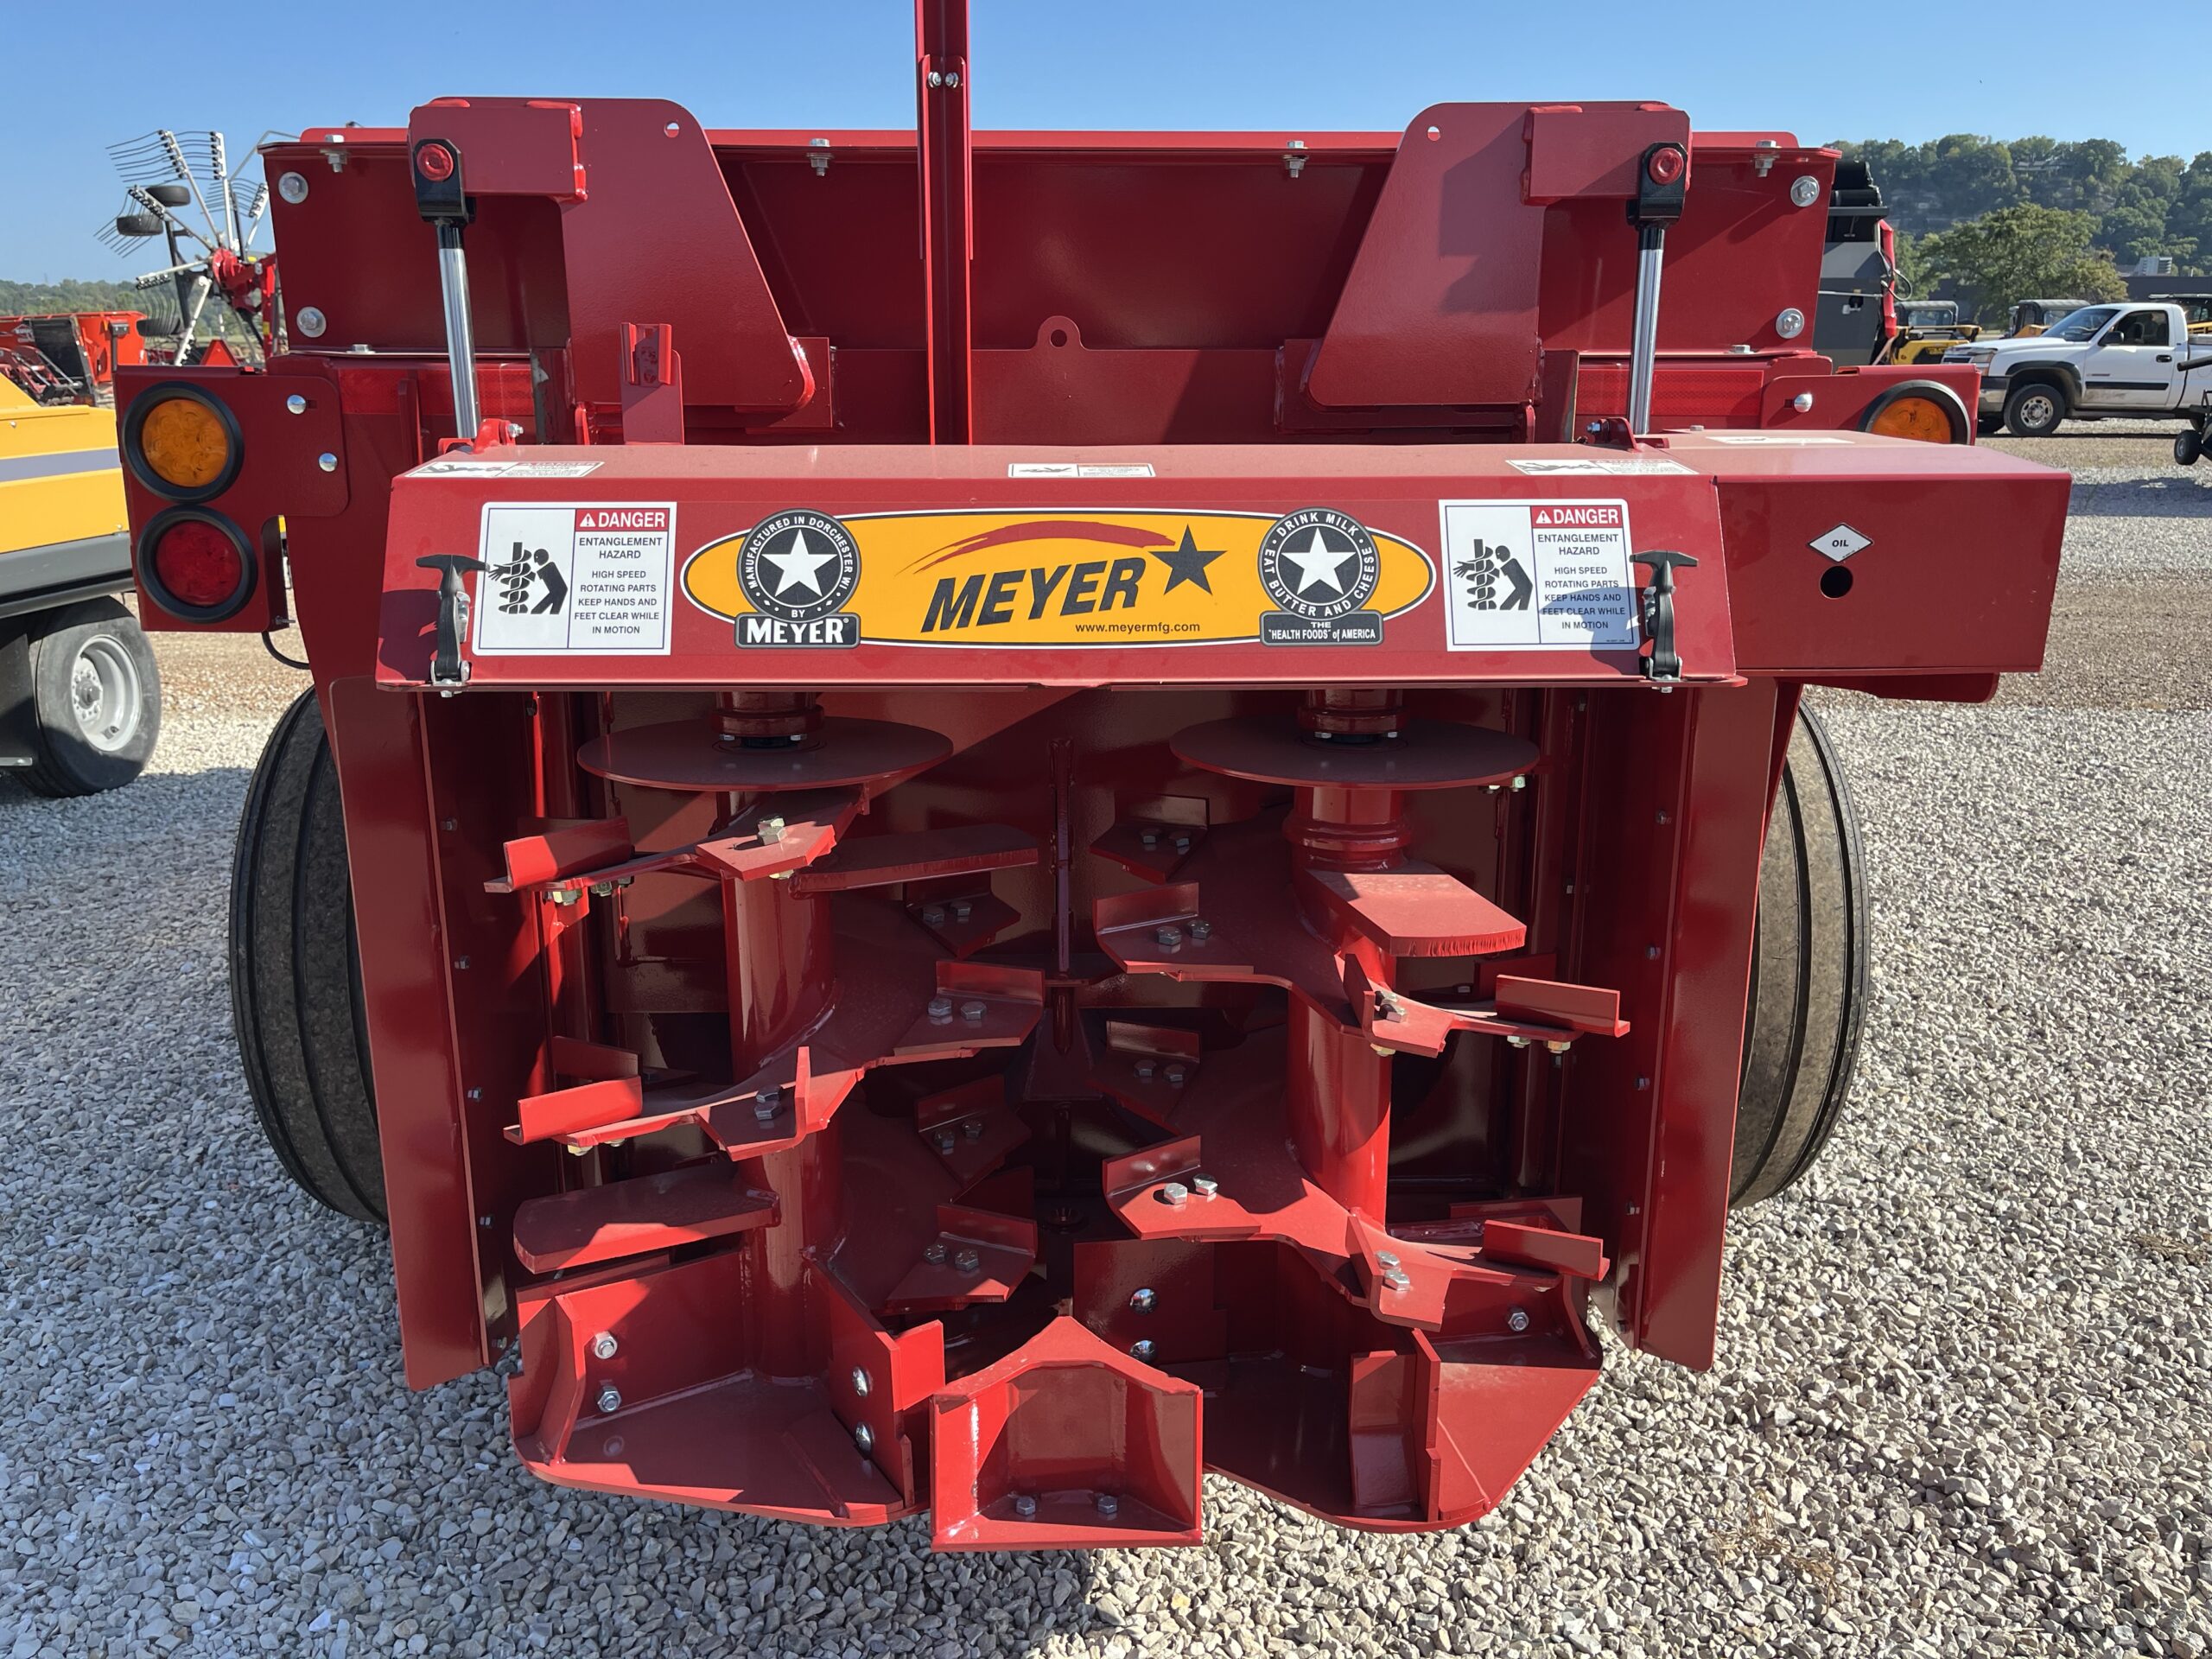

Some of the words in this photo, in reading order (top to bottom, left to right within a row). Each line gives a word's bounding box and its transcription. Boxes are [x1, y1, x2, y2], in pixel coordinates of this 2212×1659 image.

[598, 512, 665, 528] DANGER
[1553, 508, 1619, 524] DANGER
[1276, 512, 1319, 538] DRINK
[1325, 512, 1360, 537] MILK
[579, 537, 663, 546] ENTANGLEMENT
[1537, 534, 1619, 543] ENTANGLEMENT
[1832, 539, 1849, 548] OIL
[599, 550, 641, 559] HAZARD
[745, 518, 791, 589] MANUFACTURED
[794, 516, 805, 524] IN
[809, 517, 853, 574] DORCHESTER
[838, 576, 852, 590] WI
[1559, 546, 1600, 556] HAZARD
[1263, 548, 1276, 575] EAT
[592, 570, 614, 579] HIGH
[617, 570, 646, 579] SPEED
[1354, 546, 1375, 599] CHEESE
[580, 584, 626, 593] ROTATING
[627, 584, 657, 593] PARTS
[1544, 580, 1589, 588] ROTATING
[1591, 580, 1619, 588] PARTS
[920, 557, 1147, 633] MEYER
[1268, 580, 1316, 617] BUTTER
[1544, 594, 1567, 602] KEEP
[1569, 594, 1601, 602] HANDS
[1603, 594, 1622, 602] AND
[578, 598, 602, 607] KEEP
[604, 598, 636, 607] HANDS
[638, 598, 658, 607] AND
[1324, 599, 1352, 617] AND
[574, 612, 596, 620] FEET
[598, 612, 629, 620] CLEAR
[631, 612, 660, 620] WHILE
[791, 609, 805, 618] BY
[592, 626, 602, 634] IN
[603, 626, 640, 634] MOTION
[1075, 622, 1201, 635] www.meyermfg.com
[1561, 621, 1572, 630] IN
[1573, 621, 1609, 630] MOTION
[1332, 629, 1340, 642] of
[1341, 628, 1376, 639] AMERICA
